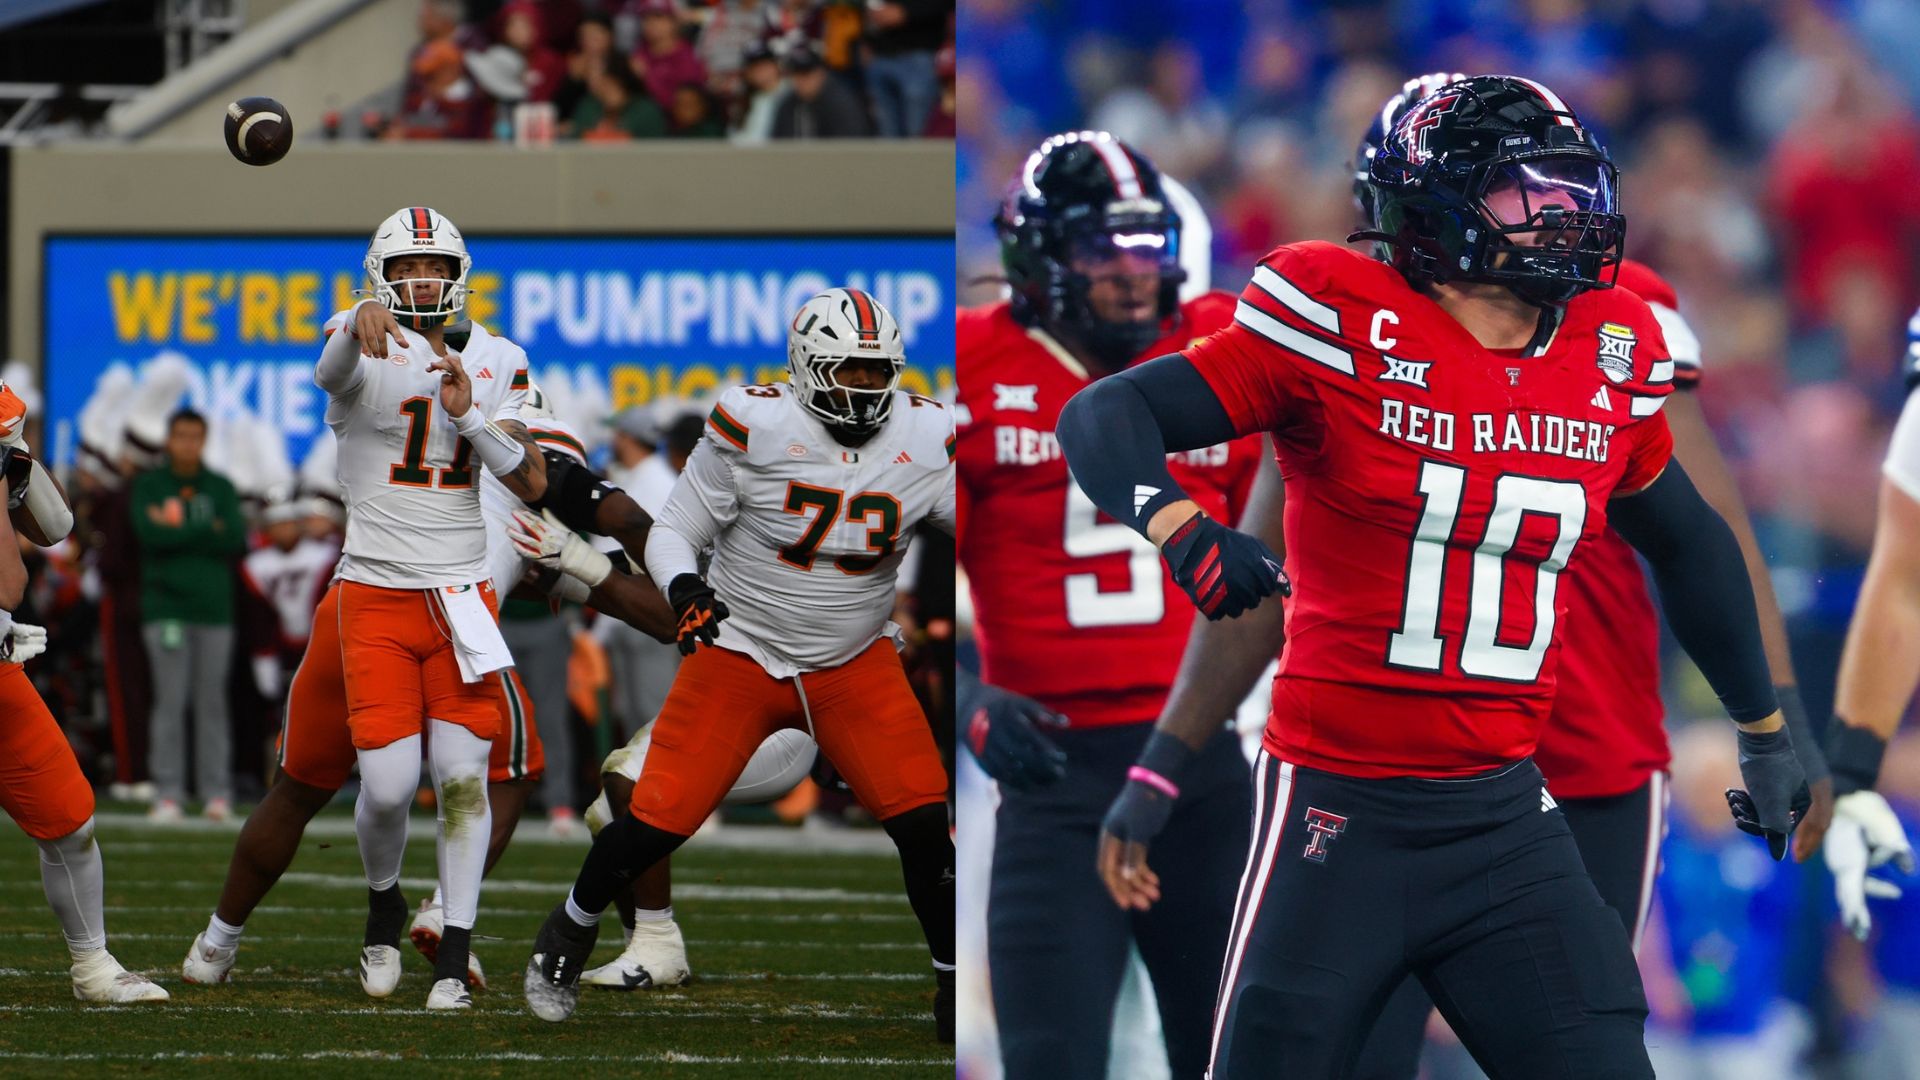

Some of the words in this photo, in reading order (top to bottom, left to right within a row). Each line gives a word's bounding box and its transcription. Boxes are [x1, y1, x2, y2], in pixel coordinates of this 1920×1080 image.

[1505, 138, 1521, 146] GUNS
[109, 272, 320, 343] WE'RE
[1370, 309, 1399, 350] C
[858, 342, 881, 350] MIAMI
[842, 451, 859, 463] U
[1379, 397, 1455, 451] RED
[1472, 412, 1615, 463] RAIDERS
[777, 480, 902, 576] 73
[1064, 475, 1165, 628] 5
[1386, 458, 1587, 684] 10
